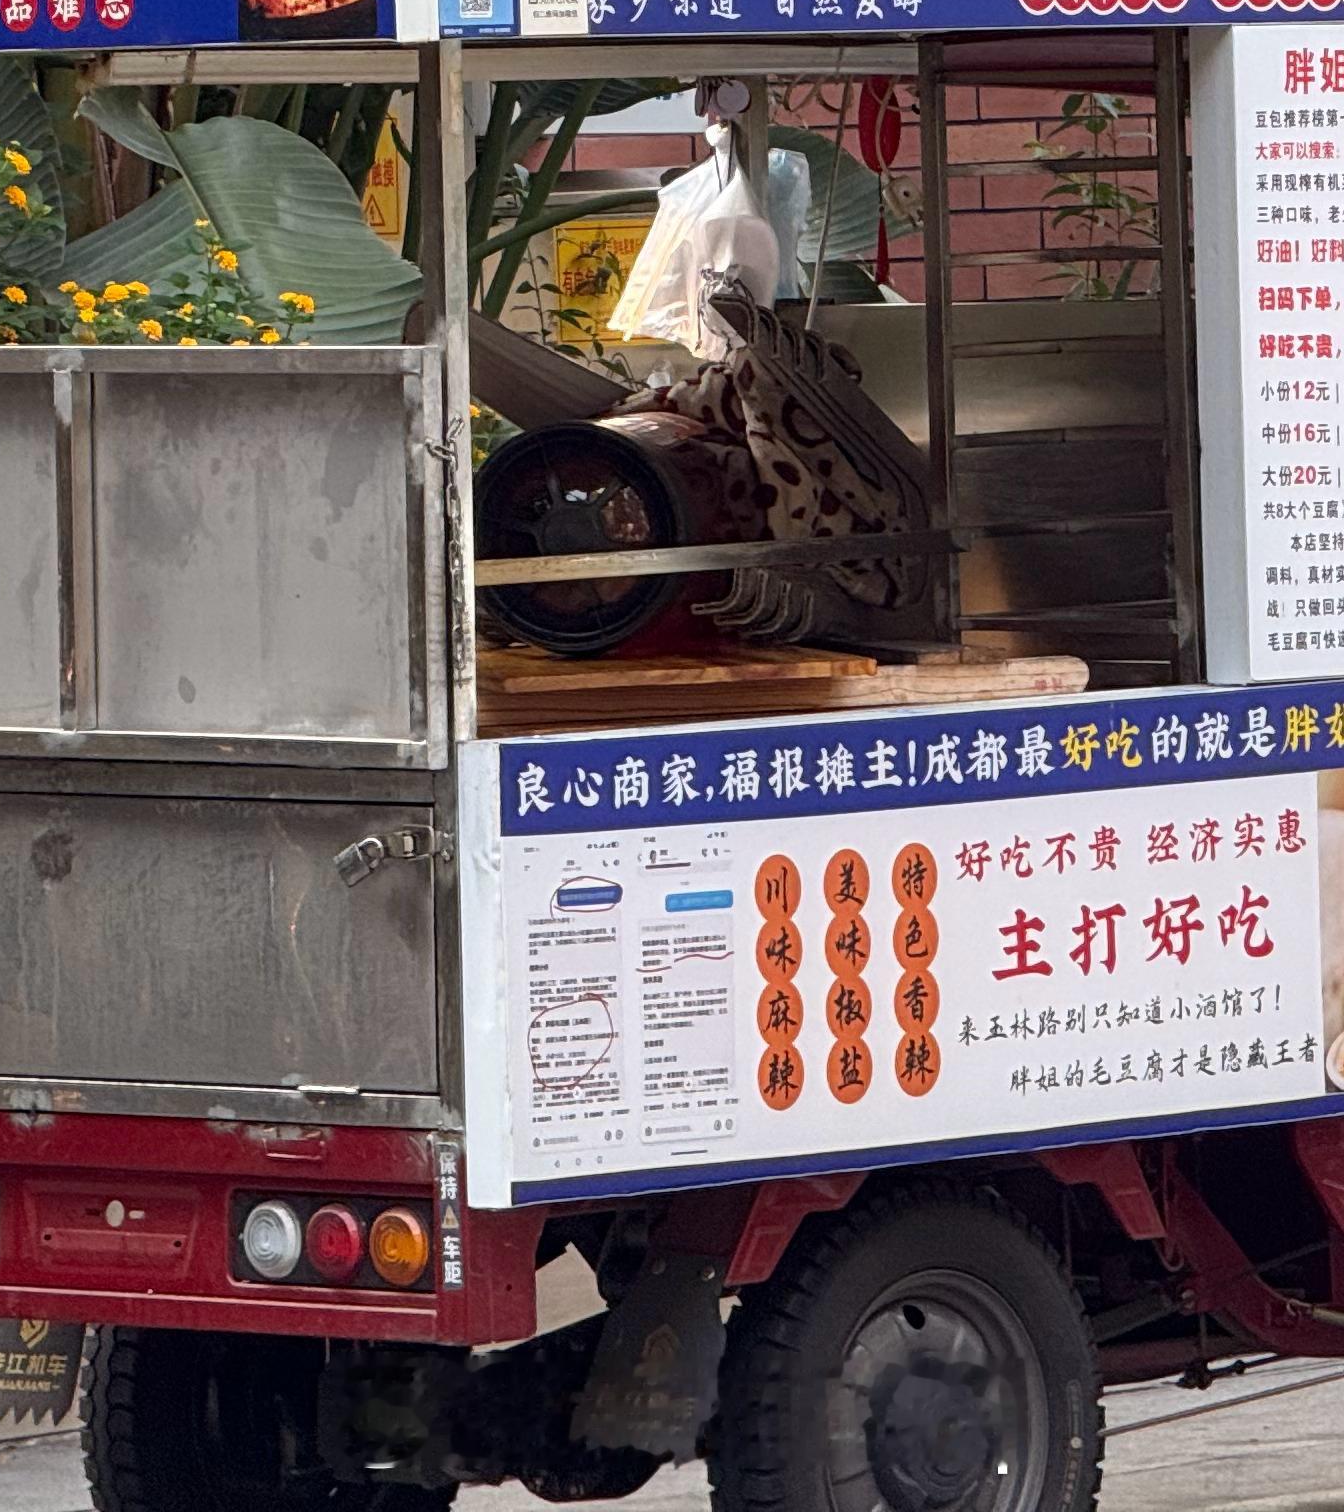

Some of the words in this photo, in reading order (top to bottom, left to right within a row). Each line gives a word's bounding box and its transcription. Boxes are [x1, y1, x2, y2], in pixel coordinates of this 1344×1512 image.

[955, 825, 1123, 882] 好吃不贵
[1147, 808, 1307, 865] 经济实惠
[834, 859, 867, 1090] 美味椒盐
[900, 852, 935, 1085] 特色香辣
[991, 884, 1275, 981] 主打好吃
[763, 866, 799, 1100] 川味麻辣
[1009, 1033, 1319, 1096] 胖姐的毛豆腐才是隐藏王者
[439, 1151, 458, 1201] 保持
[442, 1235, 463, 1284] 车距
